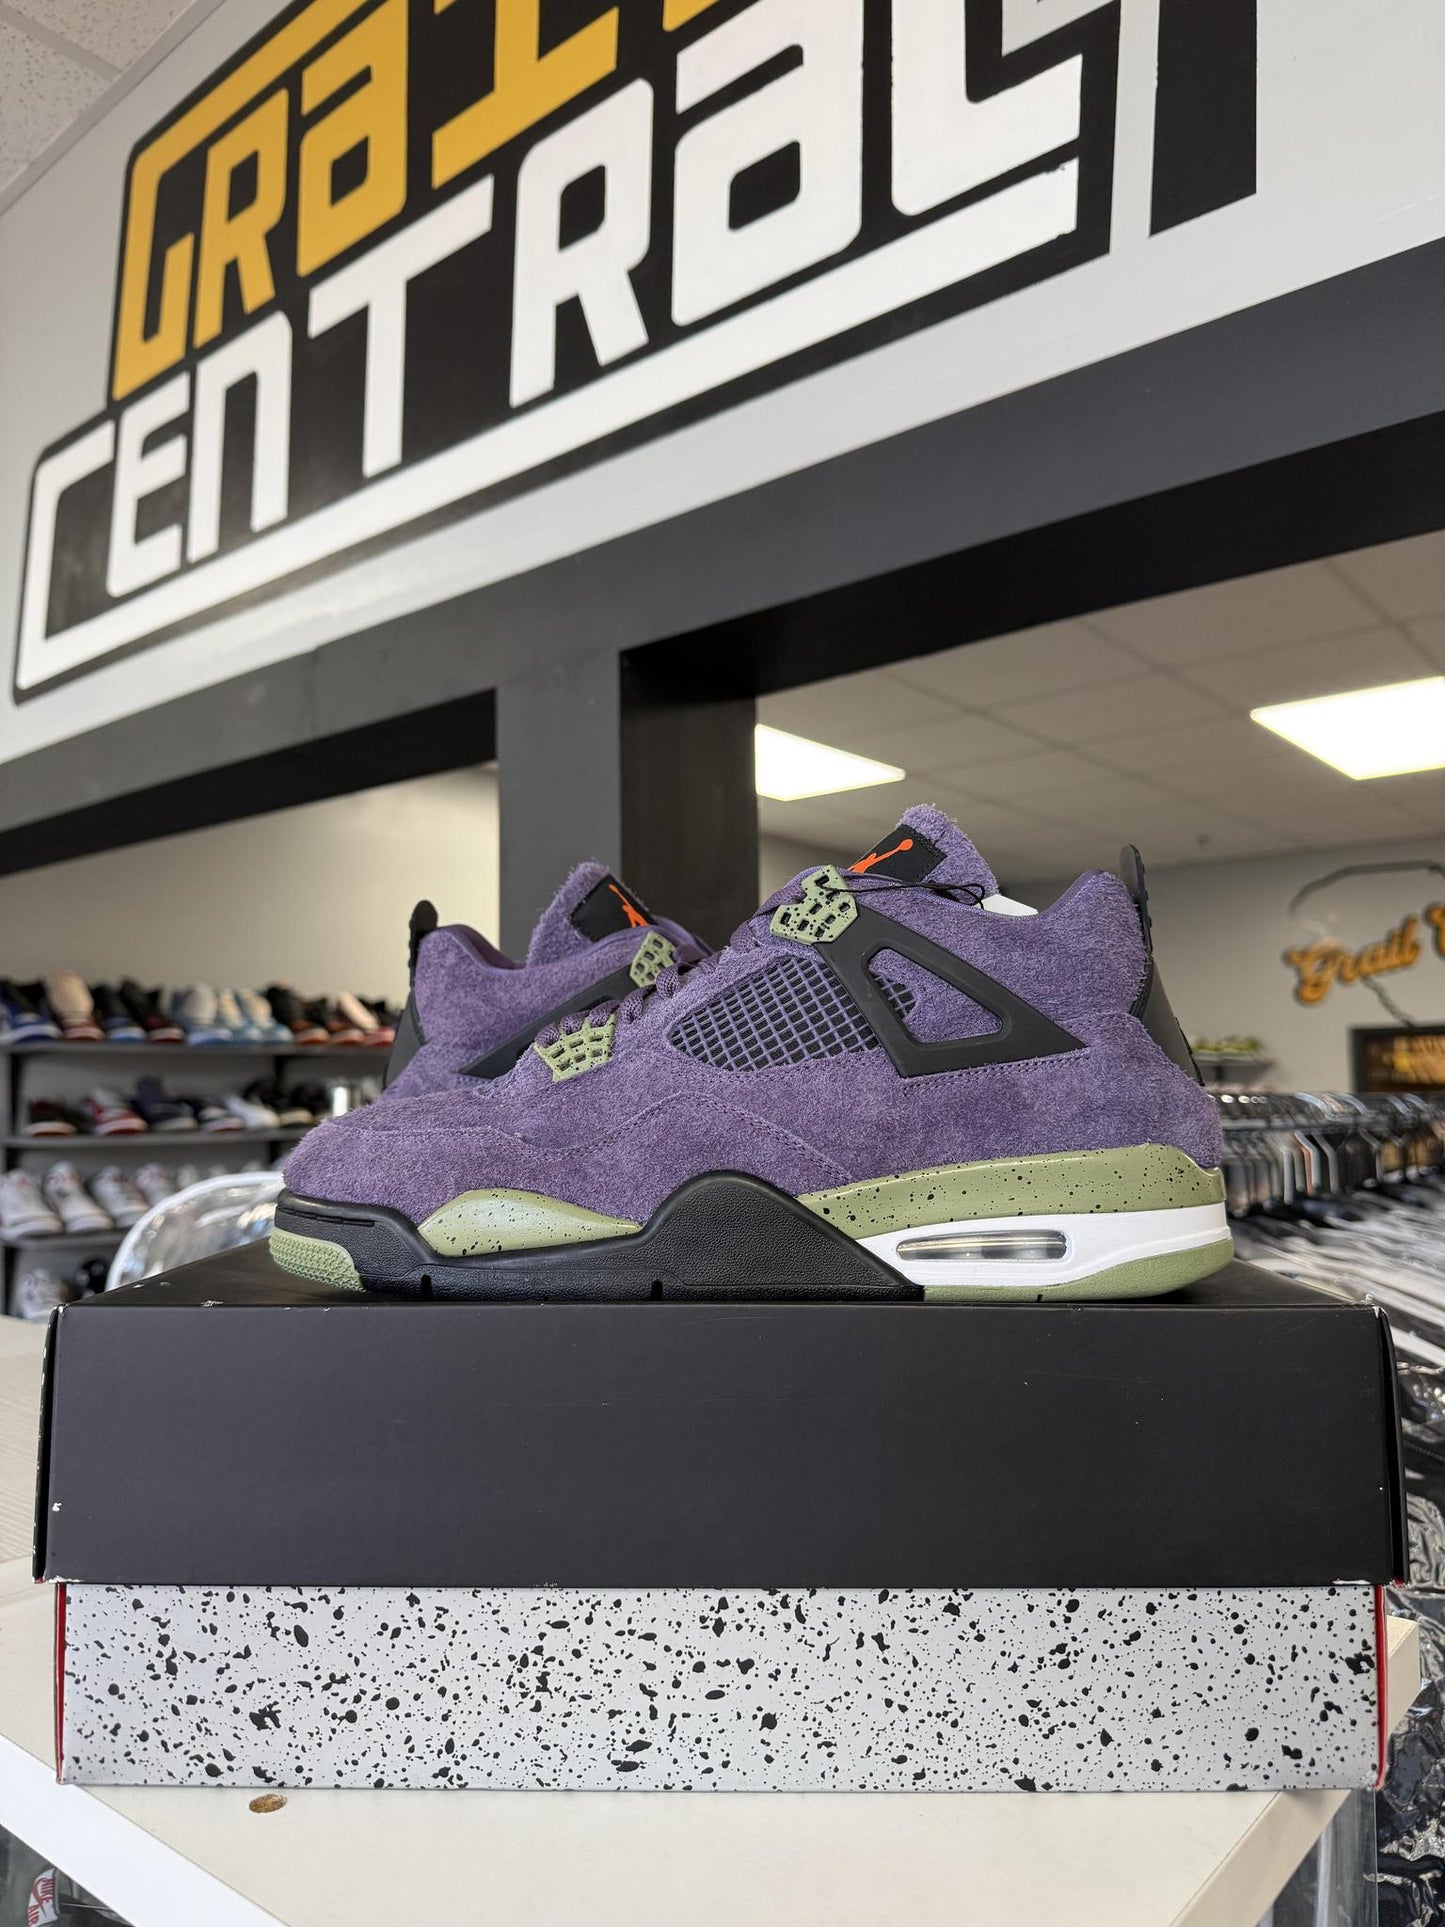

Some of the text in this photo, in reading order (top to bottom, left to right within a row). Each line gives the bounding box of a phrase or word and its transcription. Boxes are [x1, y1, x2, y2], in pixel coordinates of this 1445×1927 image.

[1283, 914, 1419, 1004] Grail
[40, 1878, 54, 1904] NIKE
[27, 1904, 40, 1926] AIR
